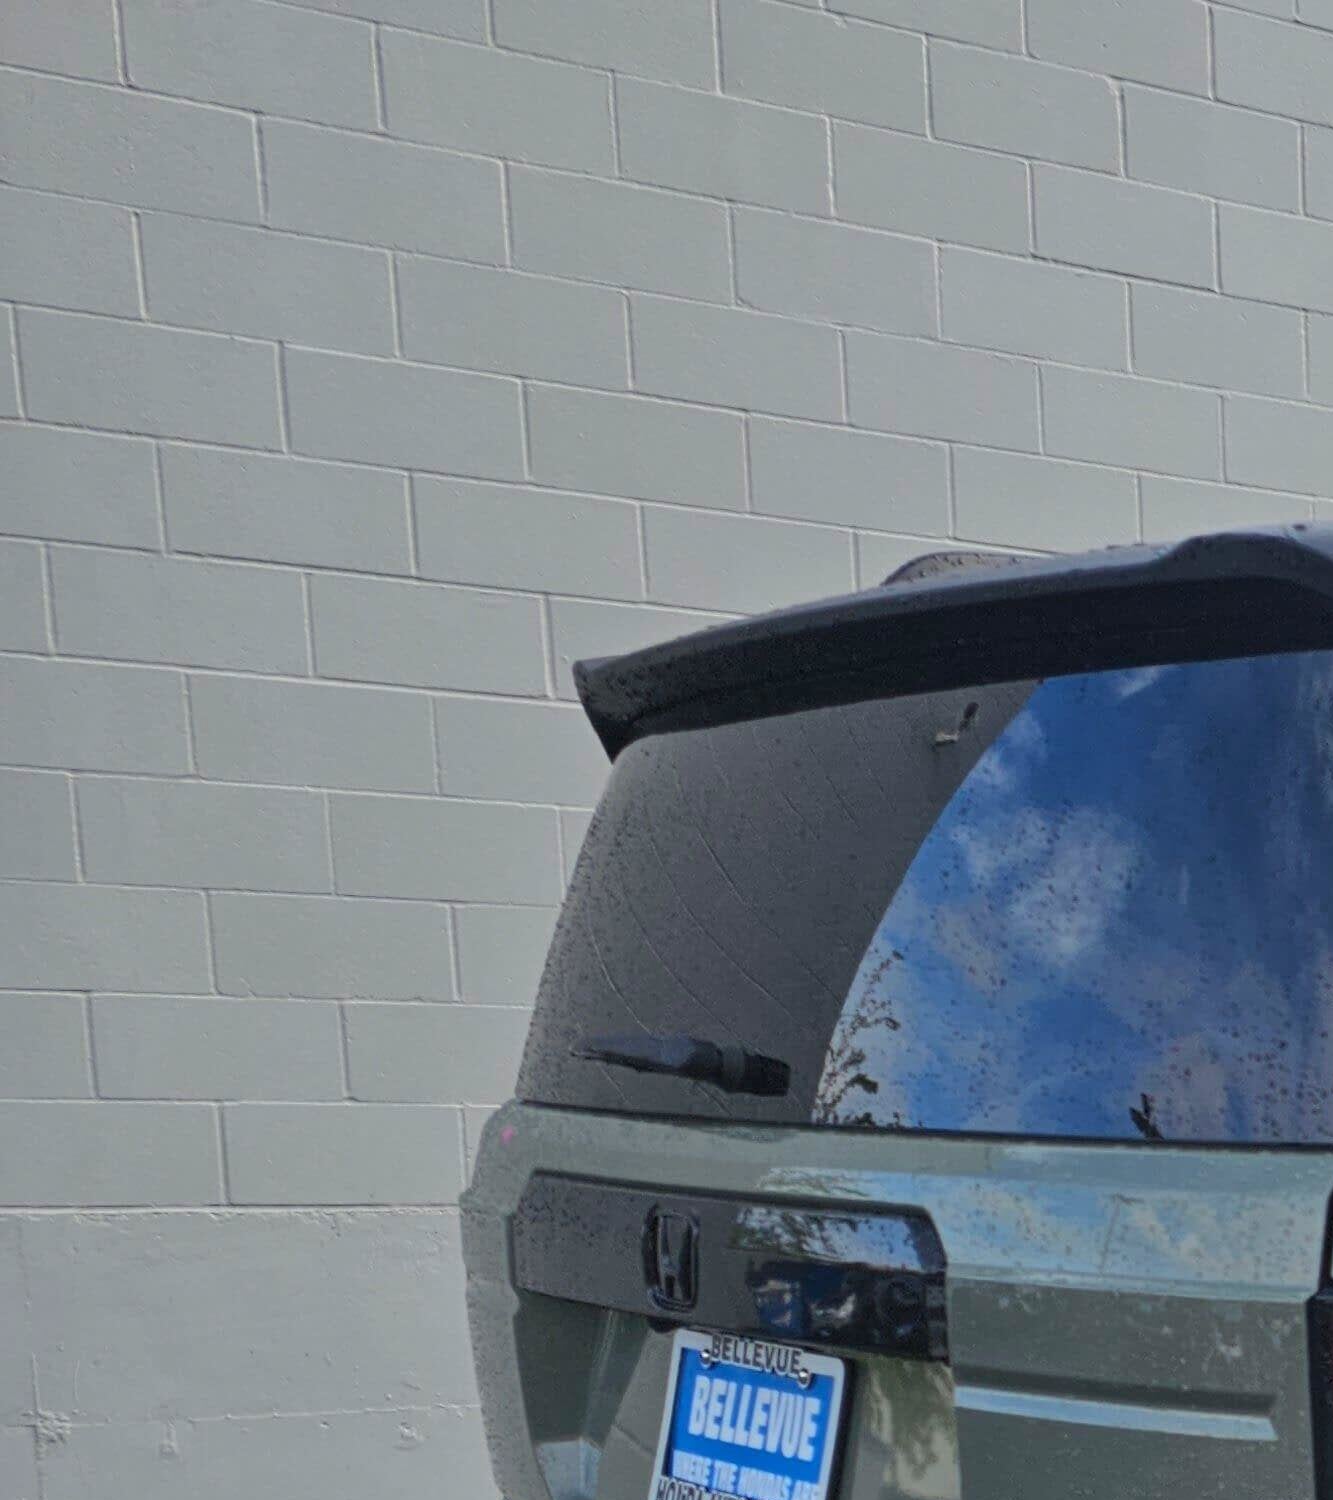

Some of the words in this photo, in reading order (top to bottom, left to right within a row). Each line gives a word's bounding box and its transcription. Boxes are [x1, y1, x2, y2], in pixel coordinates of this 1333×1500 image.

[711, 1335, 802, 1374] BELLEVUE
[688, 1374, 821, 1462] BELLEVUE
[712, 1459, 738, 1493] THE
